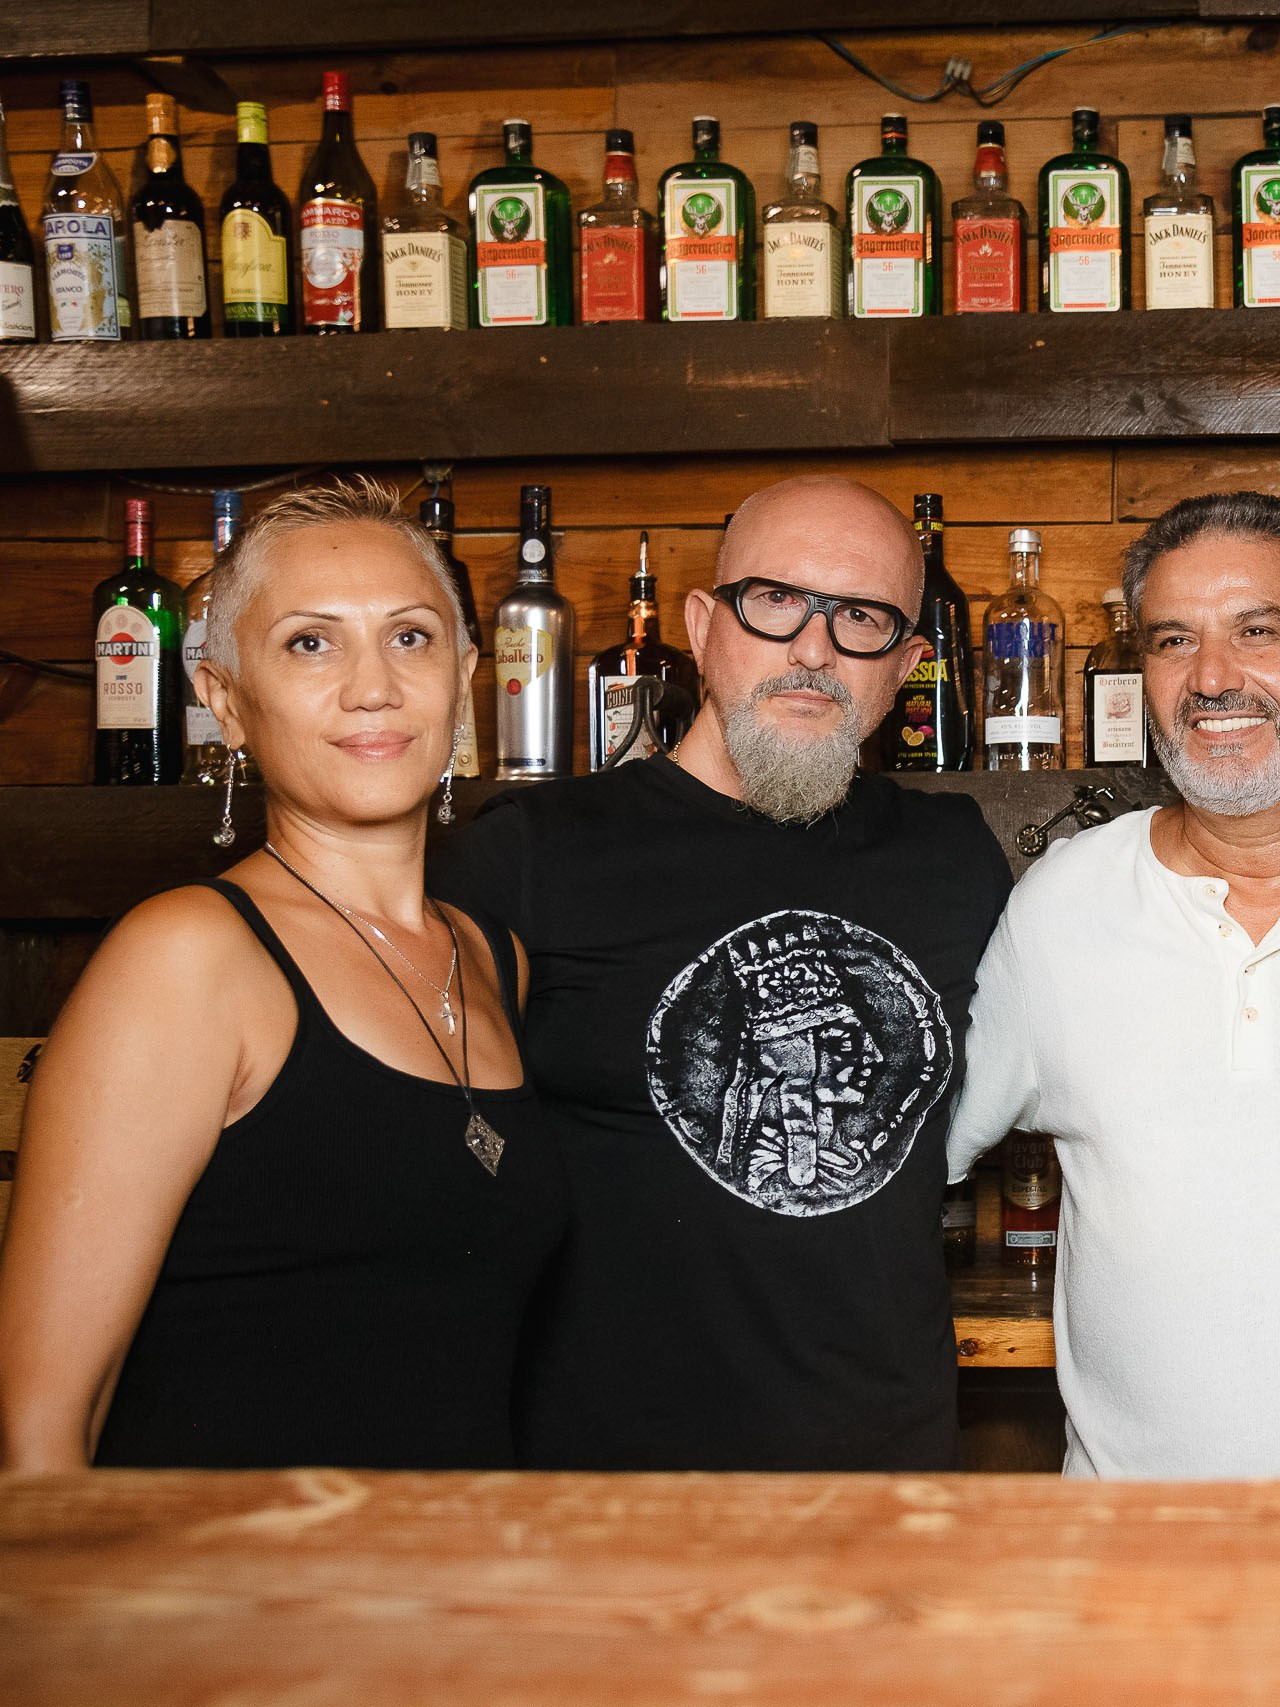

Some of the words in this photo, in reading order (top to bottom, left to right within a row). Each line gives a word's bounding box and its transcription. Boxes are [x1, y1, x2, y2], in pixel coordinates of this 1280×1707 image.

[790, 231, 826, 252] DANIEL'S
[1053, 232, 1115, 248] Jägermeister
[1149, 228, 1172, 245] JACK
[1172, 224, 1209, 244] DANIEL'S
[385, 247, 407, 264] JACK
[408, 242, 443, 263] DANIEL'S
[858, 238, 921, 254] Jägermeister
[882, 262, 893, 271] 56
[1079, 256, 1090, 265] 56
[696, 264, 707, 274] 56
[776, 279, 815, 287] HONEY
[97, 642, 154, 656] MARTINI
[104, 682, 143, 695] ROSSO
[1099, 677, 1137, 686] Herbero
[607, 687, 633, 708] COINT
